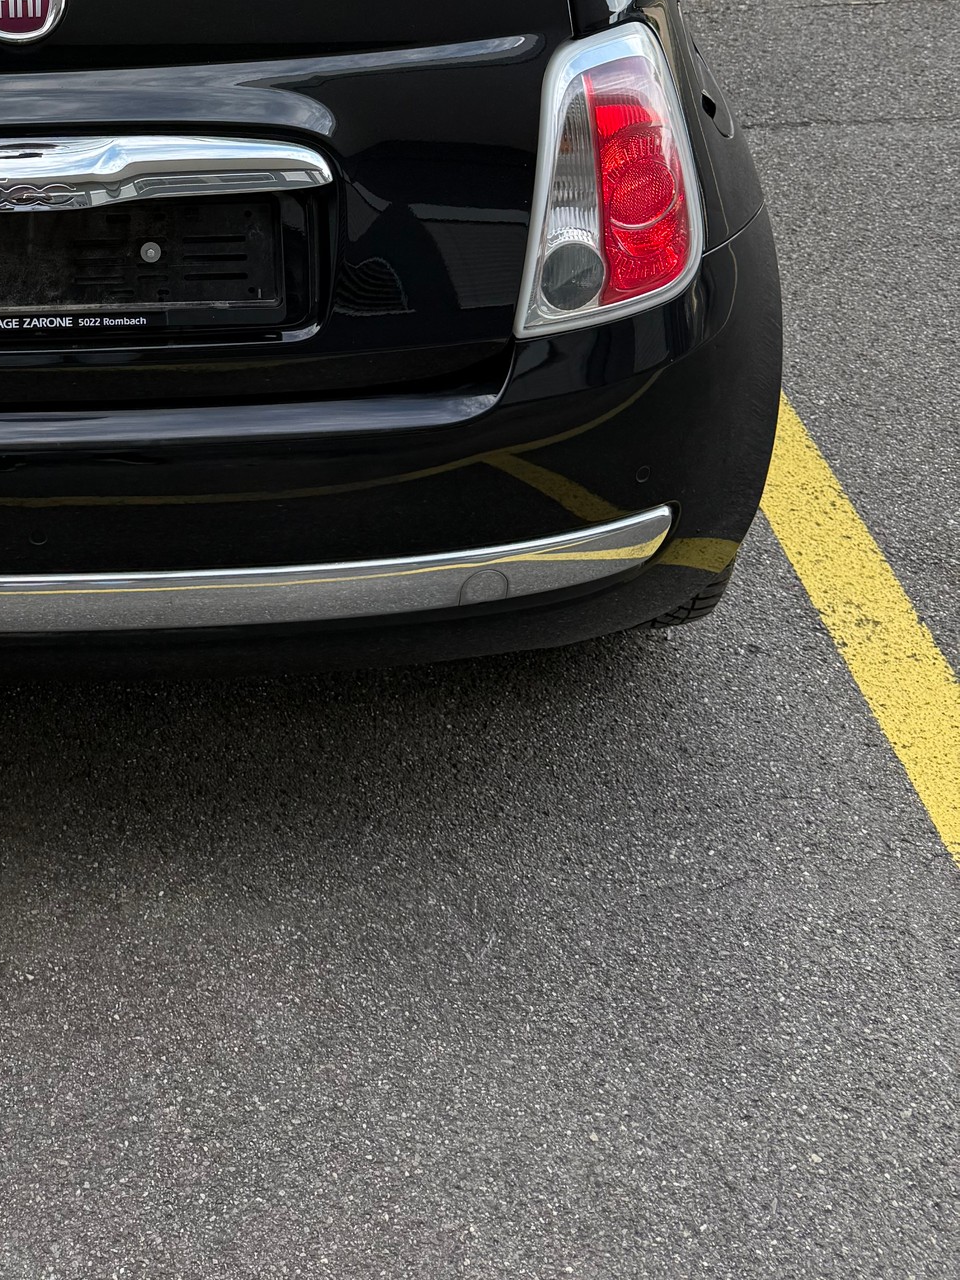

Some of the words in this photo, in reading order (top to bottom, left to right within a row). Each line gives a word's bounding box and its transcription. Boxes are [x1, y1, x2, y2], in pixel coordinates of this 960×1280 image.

[22, 317, 73, 328] ZARONE
[78, 318, 101, 327] 5022
[103, 317, 147, 326] Rombach
